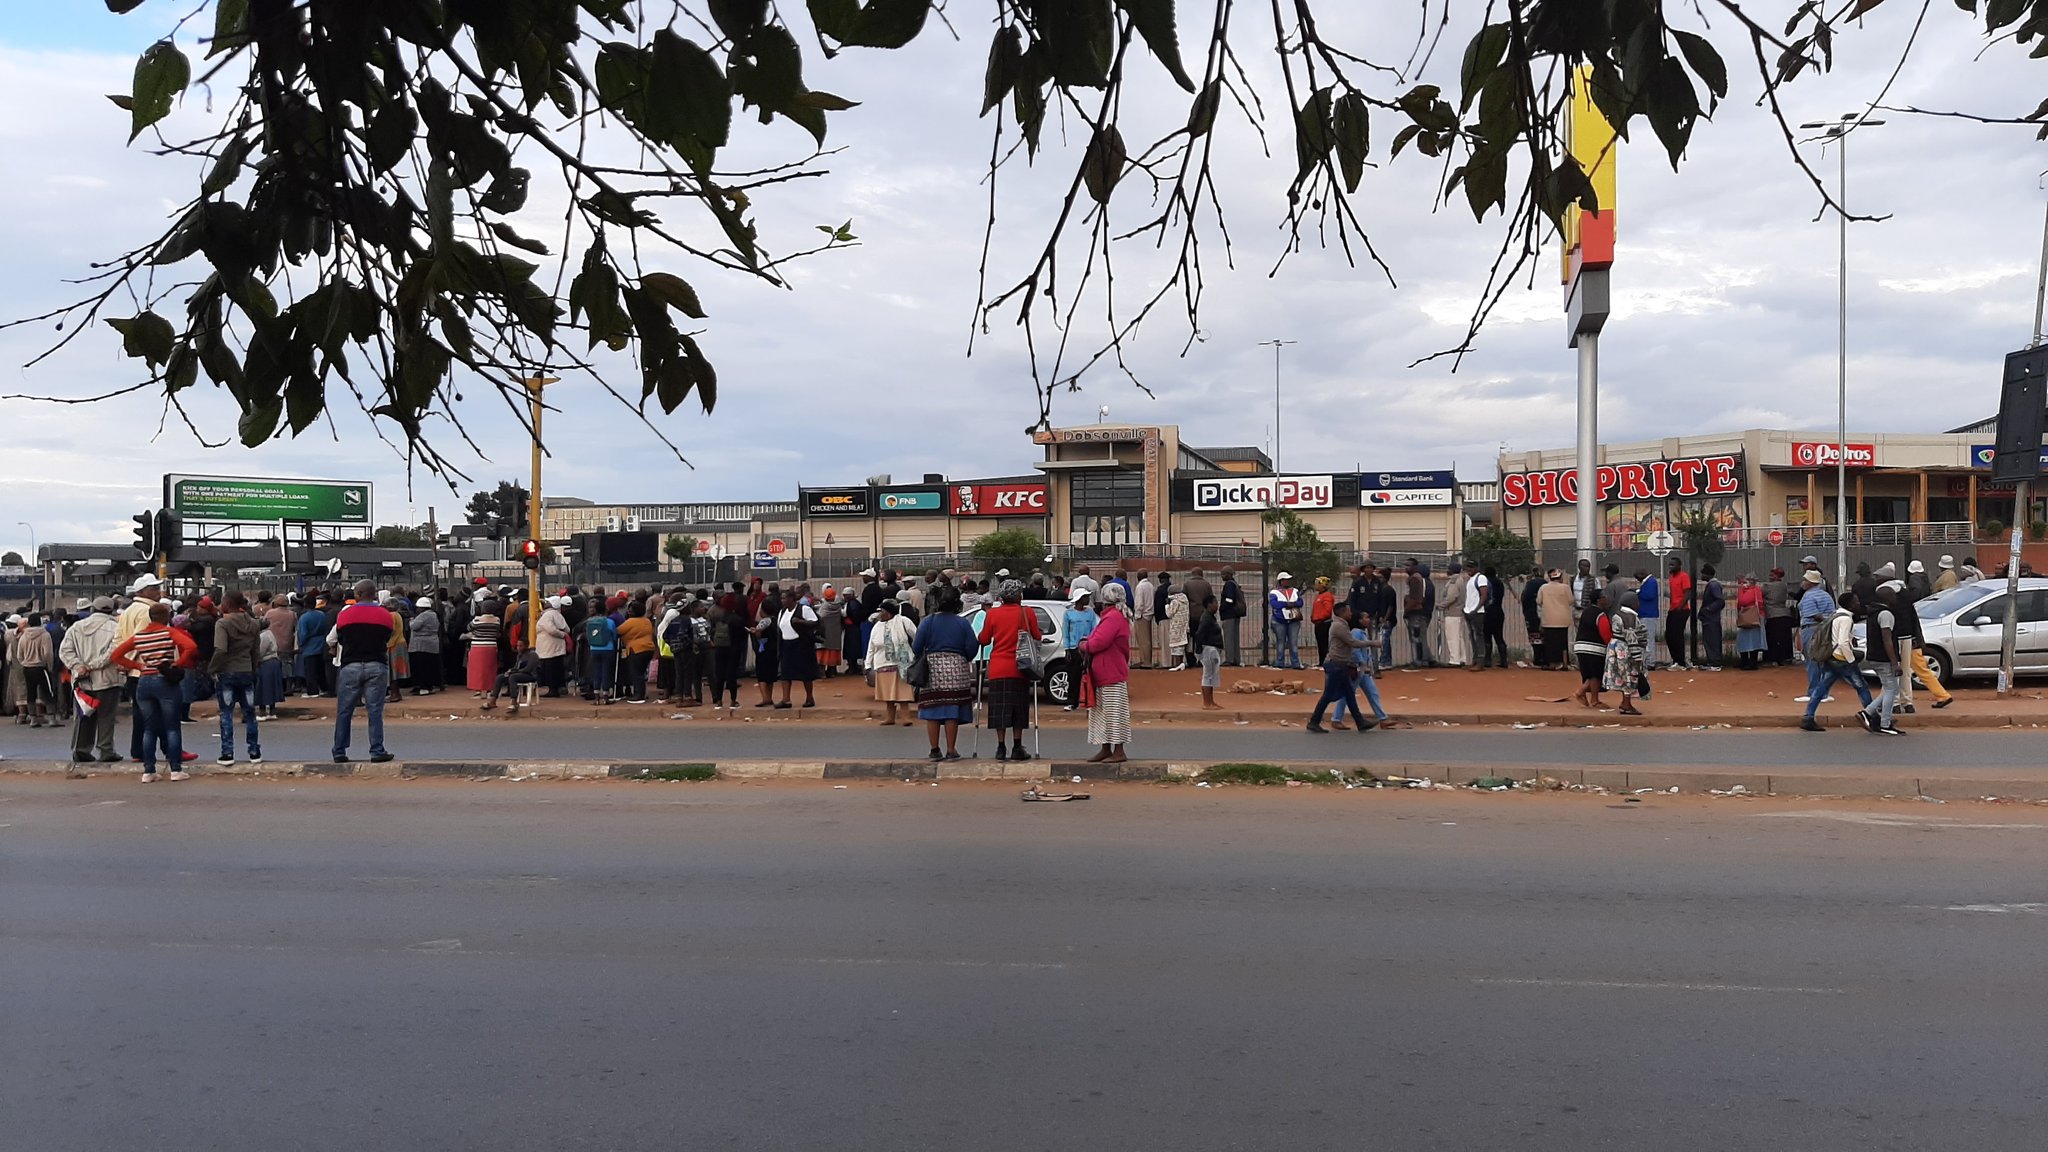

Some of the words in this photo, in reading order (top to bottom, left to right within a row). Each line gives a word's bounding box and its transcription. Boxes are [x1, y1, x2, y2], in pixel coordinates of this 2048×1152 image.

[1063, 429, 1147, 440] Dobsonville
[1503, 455, 1738, 507] SHOPRITE
[1199, 484, 1253, 506] Pick
[1257, 487, 1271, 506] n
[1276, 481, 1329, 505] Pay
[1395, 493, 1443, 501] CAPITEC
[821, 496, 853, 504] OBC
[899, 497, 917, 505] FNB
[994, 491, 1044, 507] KFC
[769, 544, 784, 552] STOP
